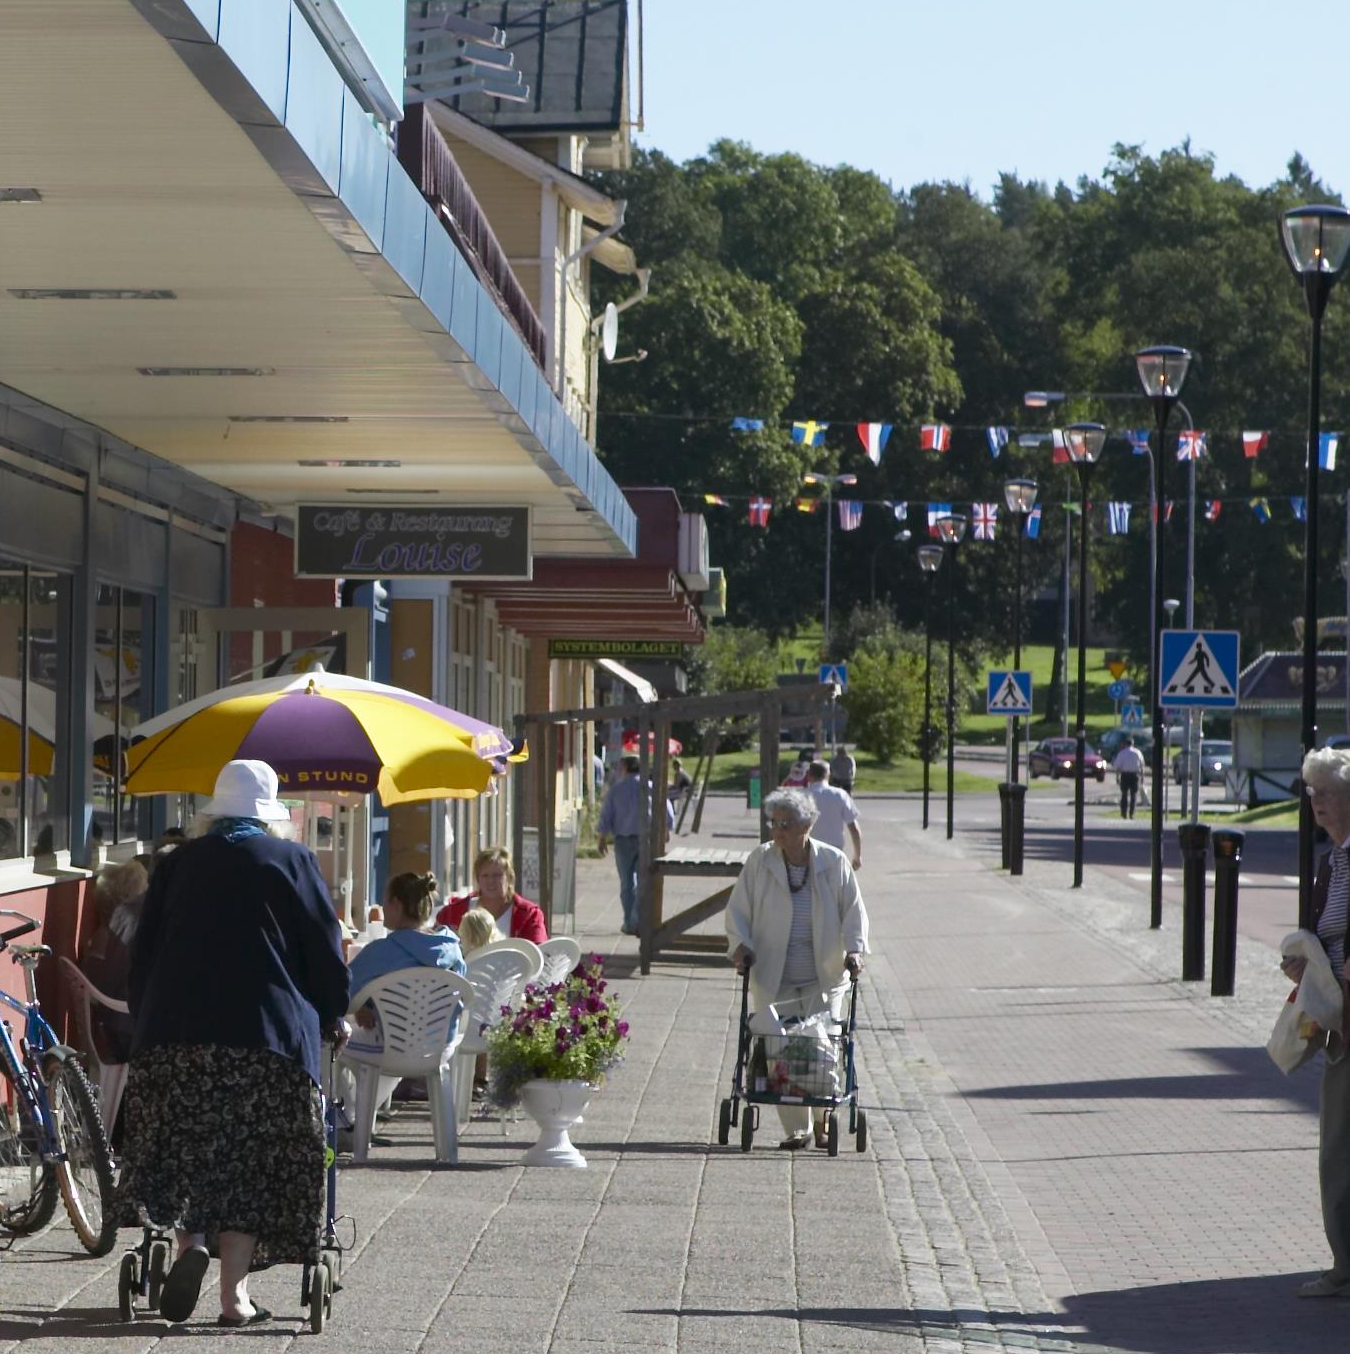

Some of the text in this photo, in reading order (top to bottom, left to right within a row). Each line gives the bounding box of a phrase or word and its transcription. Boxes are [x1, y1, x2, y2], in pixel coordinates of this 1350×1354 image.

[312, 510, 514, 538] Café & Restaurang
[342, 531, 484, 573] Louise
[553, 639, 680, 655] SYSTEMBOLAGET
[297, 770, 369, 785] STUND
